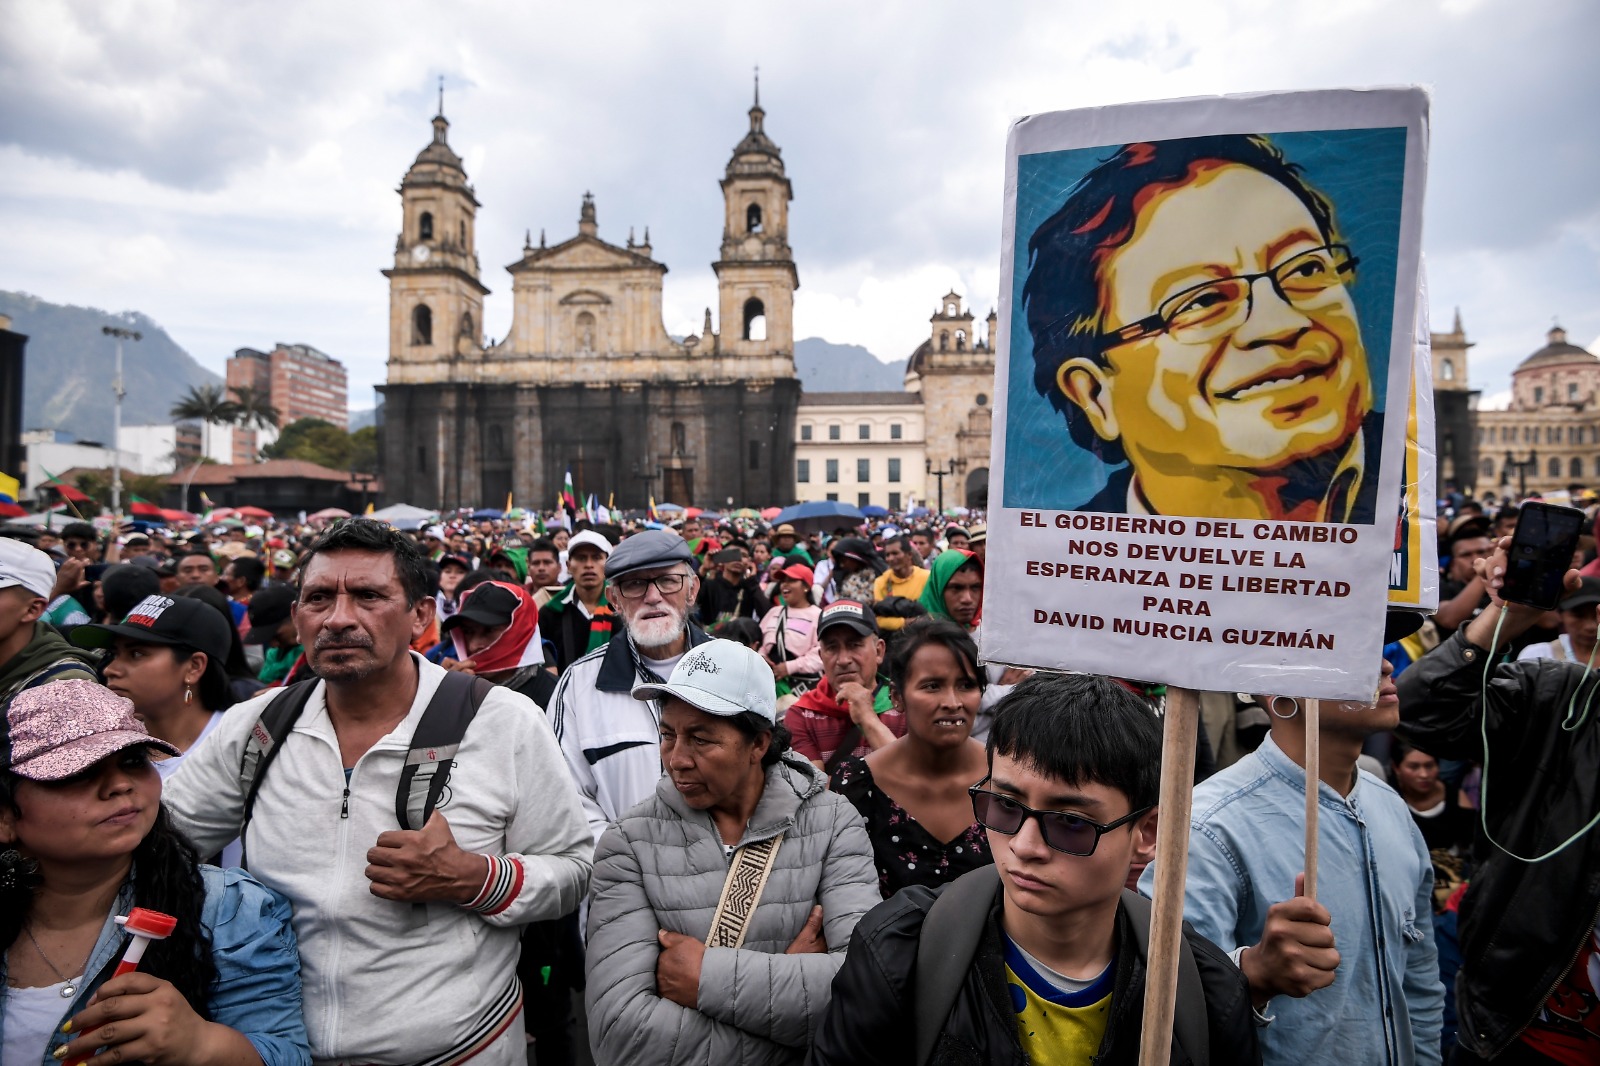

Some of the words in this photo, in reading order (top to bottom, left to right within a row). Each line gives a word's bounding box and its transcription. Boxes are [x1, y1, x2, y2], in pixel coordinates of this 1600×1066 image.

[1020, 511, 1048, 528] EL
[1054, 513, 1186, 537] GOBIERNO
[1195, 521, 1245, 539] DEL
[1253, 523, 1358, 544] CAMBIO
[1068, 539, 1119, 558] NOS
[1127, 543, 1265, 567] DEVUELVE
[1273, 551, 1306, 569] LA
[1026, 560, 1171, 588] ESPERANZA
[1179, 572, 1213, 591] DE
[1221, 575, 1351, 598] LIBERTAD
[1142, 595, 1212, 617] PARA
[1033, 608, 1105, 631] DAVID
[1112, 617, 1214, 643] MURCIA
[1221, 627, 1335, 651] GUZMÁN
